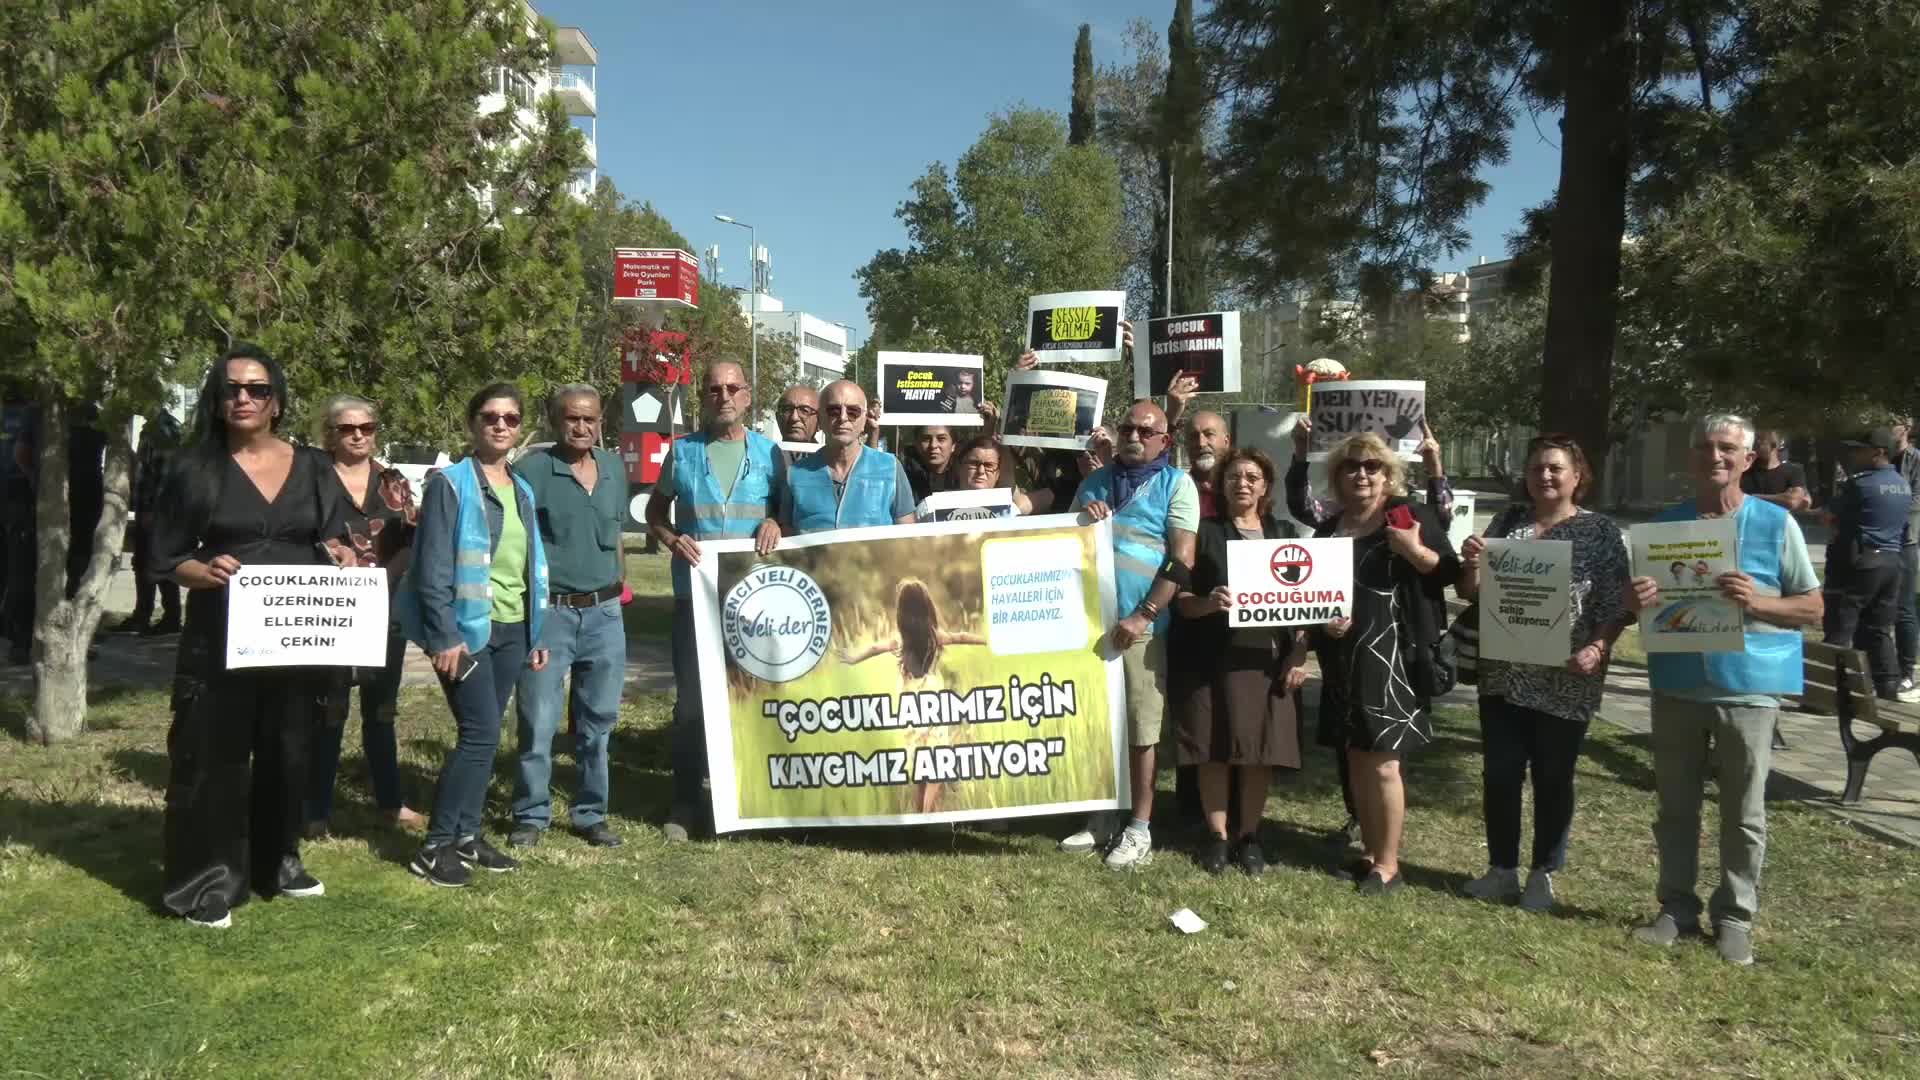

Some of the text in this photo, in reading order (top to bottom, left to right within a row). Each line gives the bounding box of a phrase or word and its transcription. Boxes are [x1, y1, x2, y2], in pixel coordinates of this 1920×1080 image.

[1055, 322, 1090, 338] KALMA
[1167, 320, 1205, 337] ÇOCUK
[1152, 337, 1223, 355] İSTİSMARINA
[1361, 390, 1398, 408] YER
[1488, 548, 1556, 575] Veli-der
[239, 576, 379, 589] ÇOCUKLARIMIZIN
[756, 570, 795, 585] VELİ
[263, 594, 357, 608] ÜZERİNDEN
[991, 586, 1064, 605] HAYALLERİ İÇİN
[1237, 588, 1345, 608] ÇOCUĞUMA
[264, 615, 353, 628] ELLERİNİZİ
[992, 607, 1063, 625] BİR ARADAYIZ.
[1238, 606, 1343, 622] DOKUNMA
[740, 609, 812, 638] Veli-der
[280, 635, 336, 648] ÇEKİN!
[763, 672, 1076, 741] "ÇOCUKLARIMIZ İÇİN
[768, 737, 1065, 789] KAYGIMIZ ARTIYOR"
